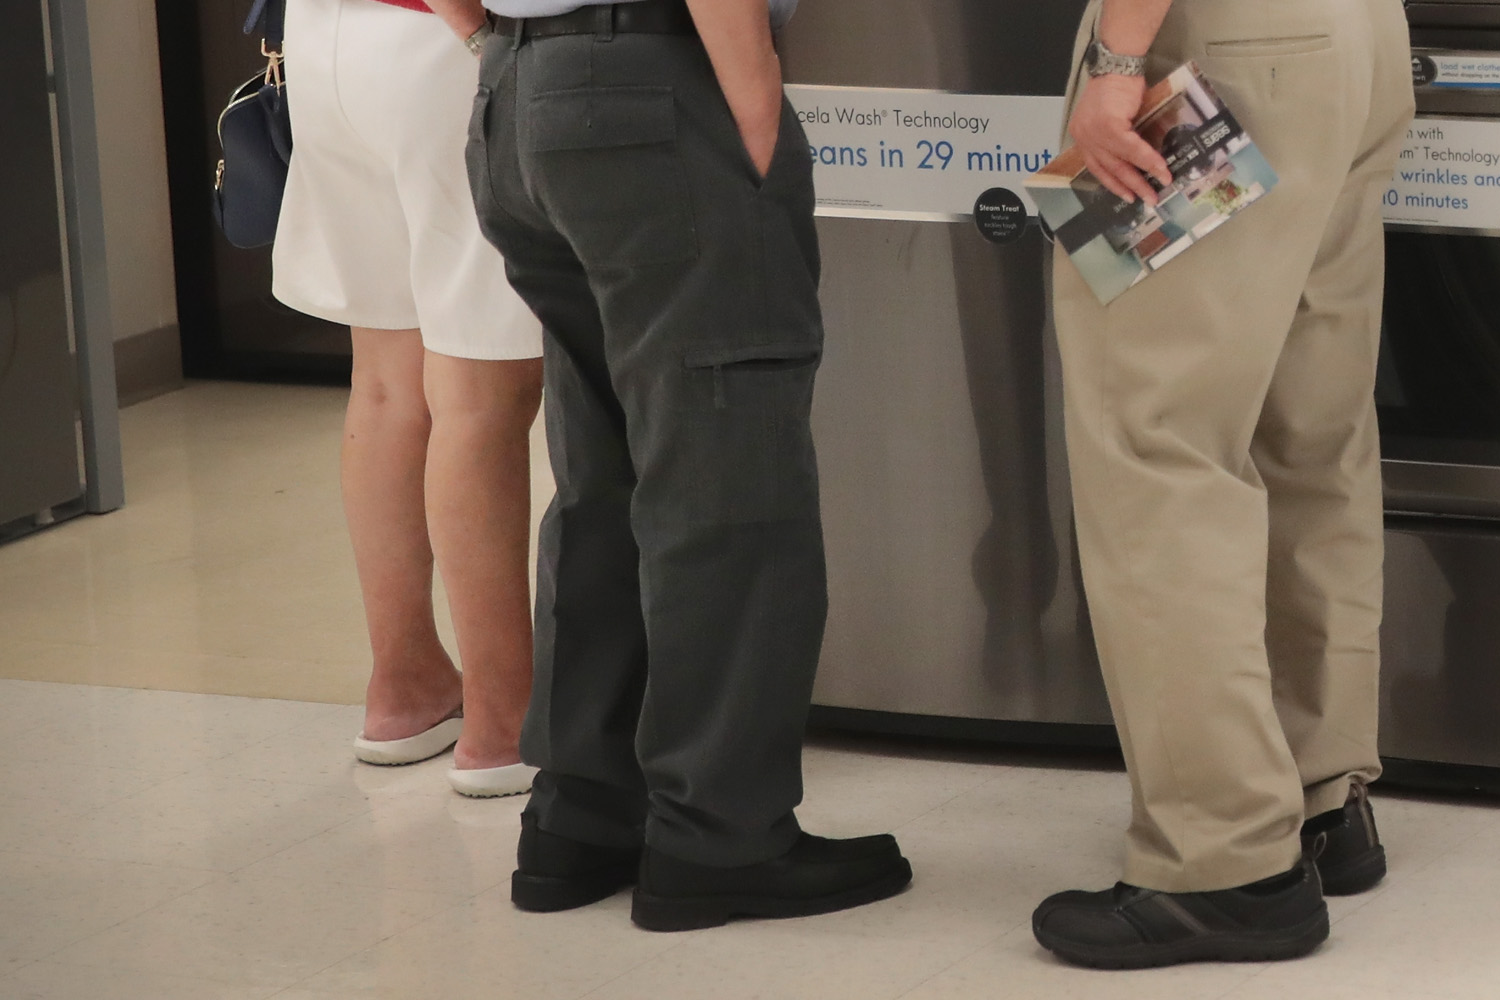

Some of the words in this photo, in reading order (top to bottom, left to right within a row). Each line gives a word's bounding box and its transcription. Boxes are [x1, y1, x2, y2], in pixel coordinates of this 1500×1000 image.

[893, 109, 990, 134] Technology
[1416, 127, 1444, 140] with
[880, 141, 904, 167] in
[916, 140, 954, 170] 29
[1423, 146, 1500, 167] Technology
[1400, 168, 1468, 186] wrinkles
[979, 204, 1001, 212] Steam
[1002, 204, 1020, 212] Treat
[1405, 192, 1469, 210] minutes
